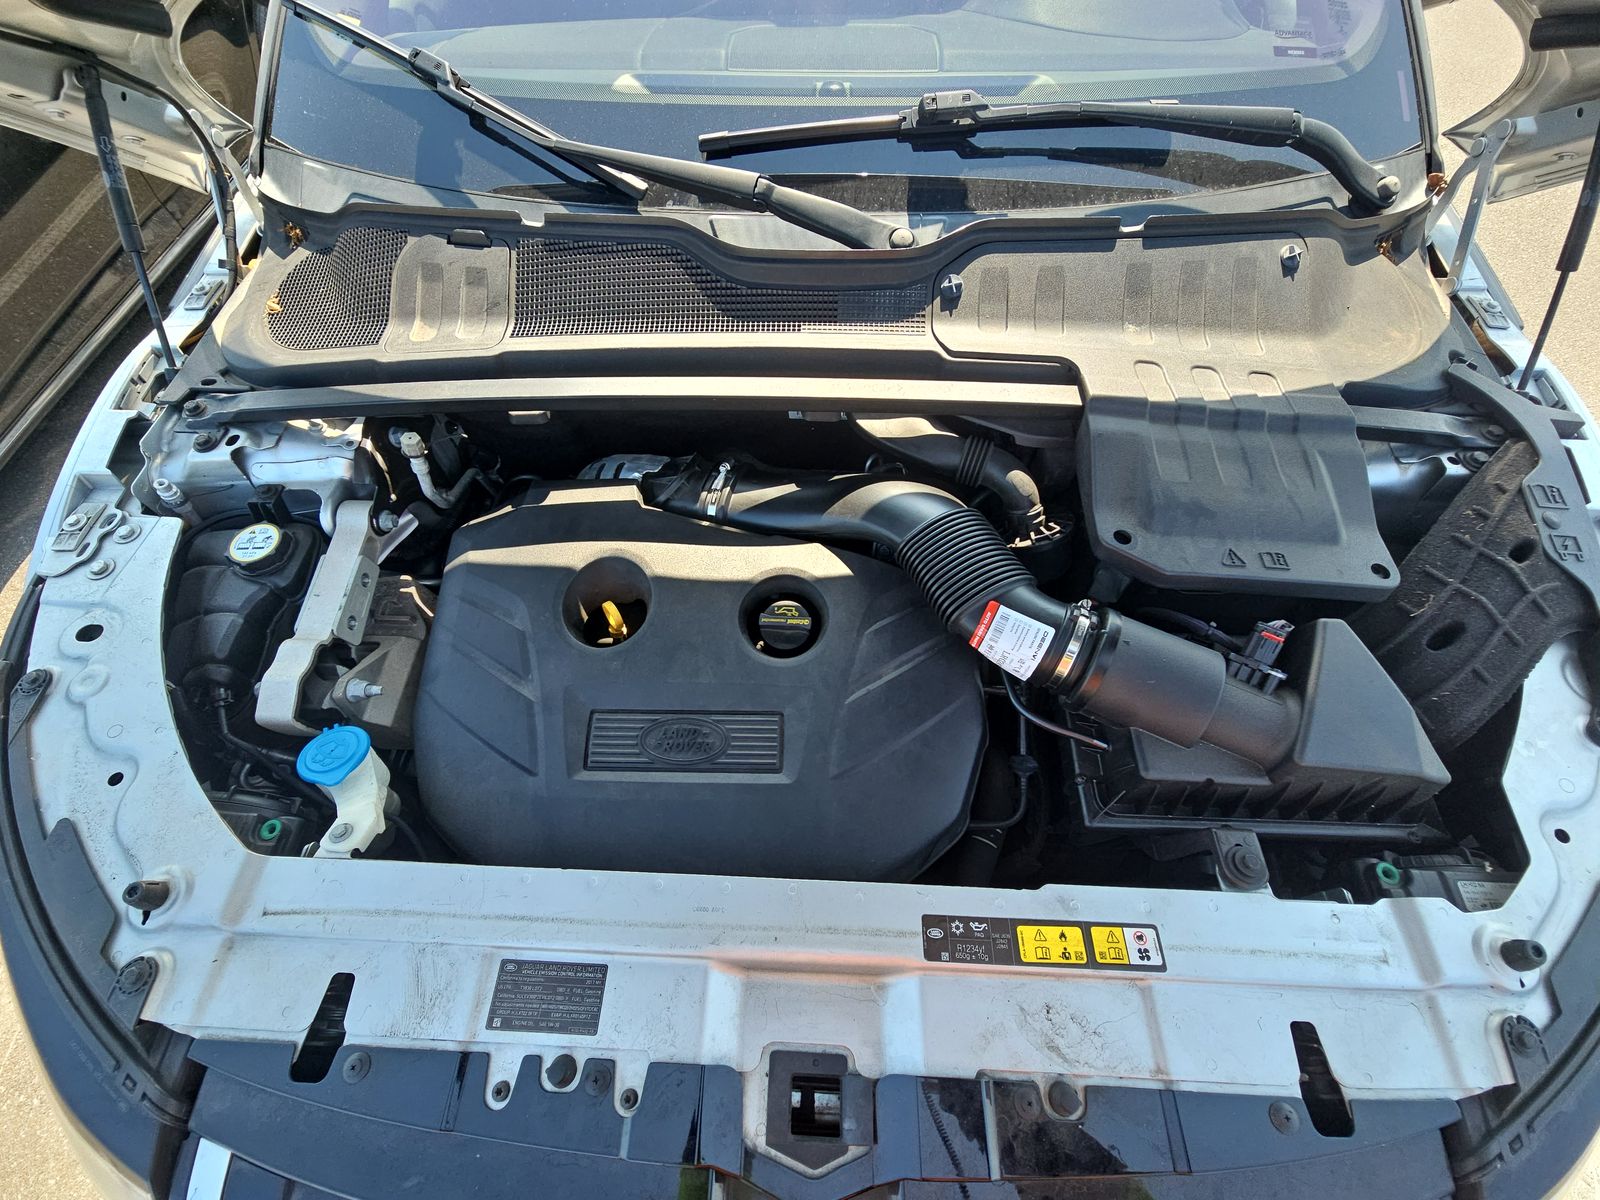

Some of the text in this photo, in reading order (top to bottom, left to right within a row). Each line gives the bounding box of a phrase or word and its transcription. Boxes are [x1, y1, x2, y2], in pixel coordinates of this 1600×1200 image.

[661, 727, 699, 739] LAND
[663, 740, 714, 752] ROVER
[956, 943, 985, 954] R1234yf
[955, 952, 970, 961] 650g
[977, 953, 989, 961] 10g
